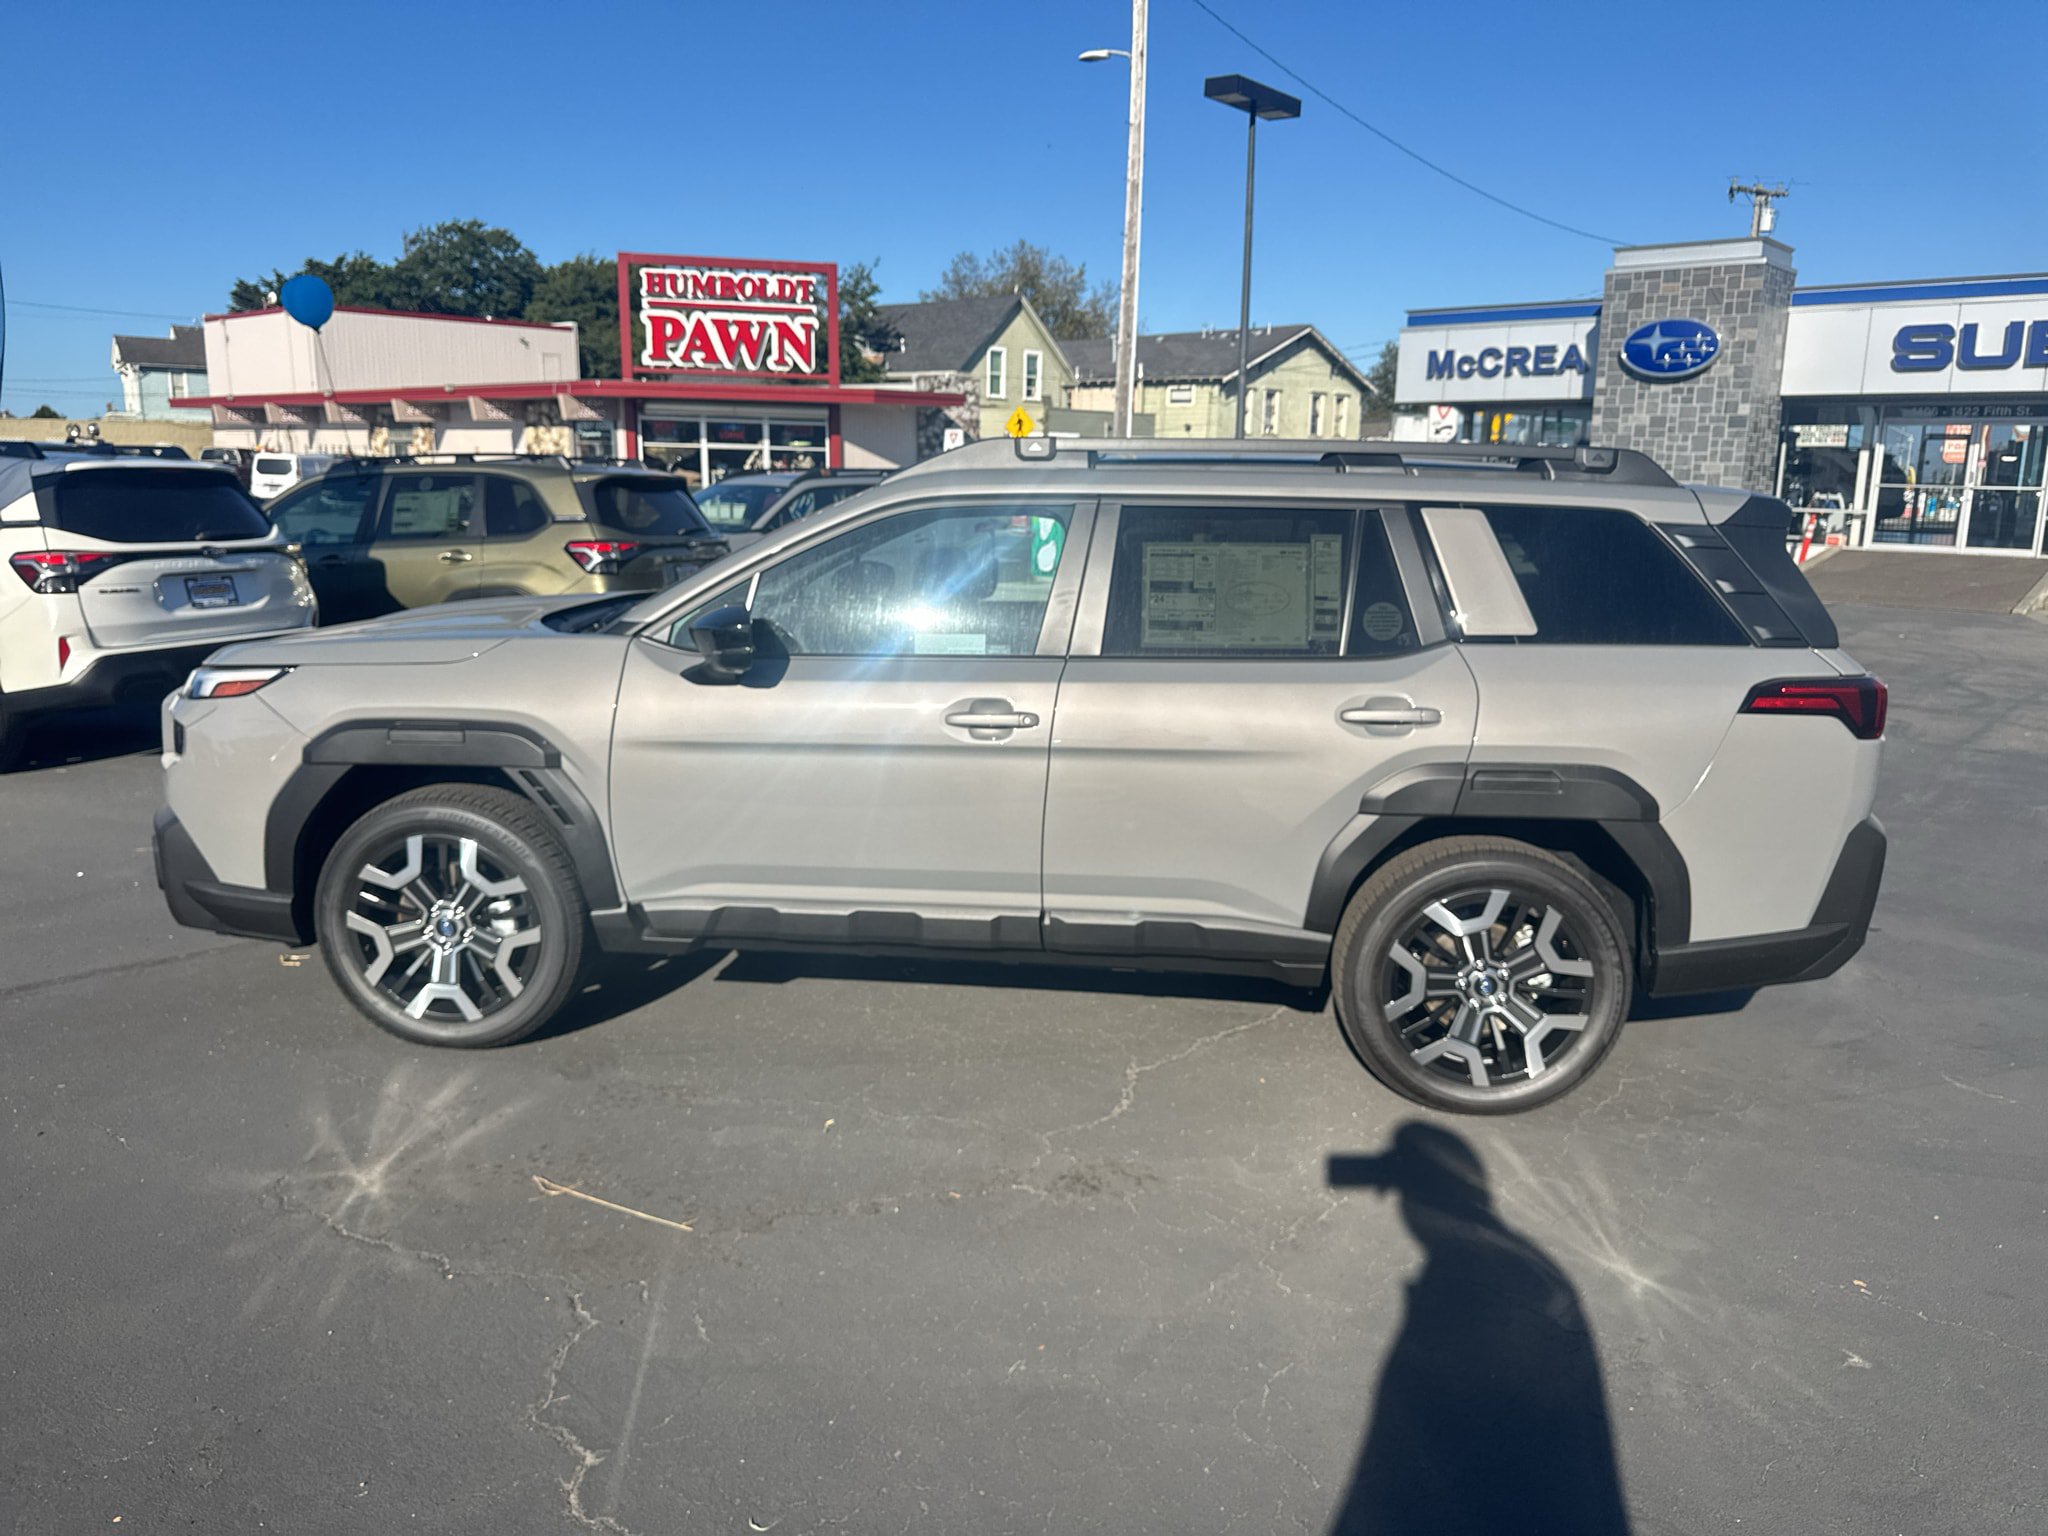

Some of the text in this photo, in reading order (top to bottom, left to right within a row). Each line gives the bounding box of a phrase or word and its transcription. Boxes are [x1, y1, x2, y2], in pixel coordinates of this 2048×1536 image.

[641, 268, 816, 302] HUMBOLDT
[641, 309, 819, 374] PAWN
[1426, 343, 1589, 381] McCREA
[1951, 406, 1980, 417] 1422
[1983, 404, 2013, 416] Fifth
[2016, 405, 2034, 416] St.
